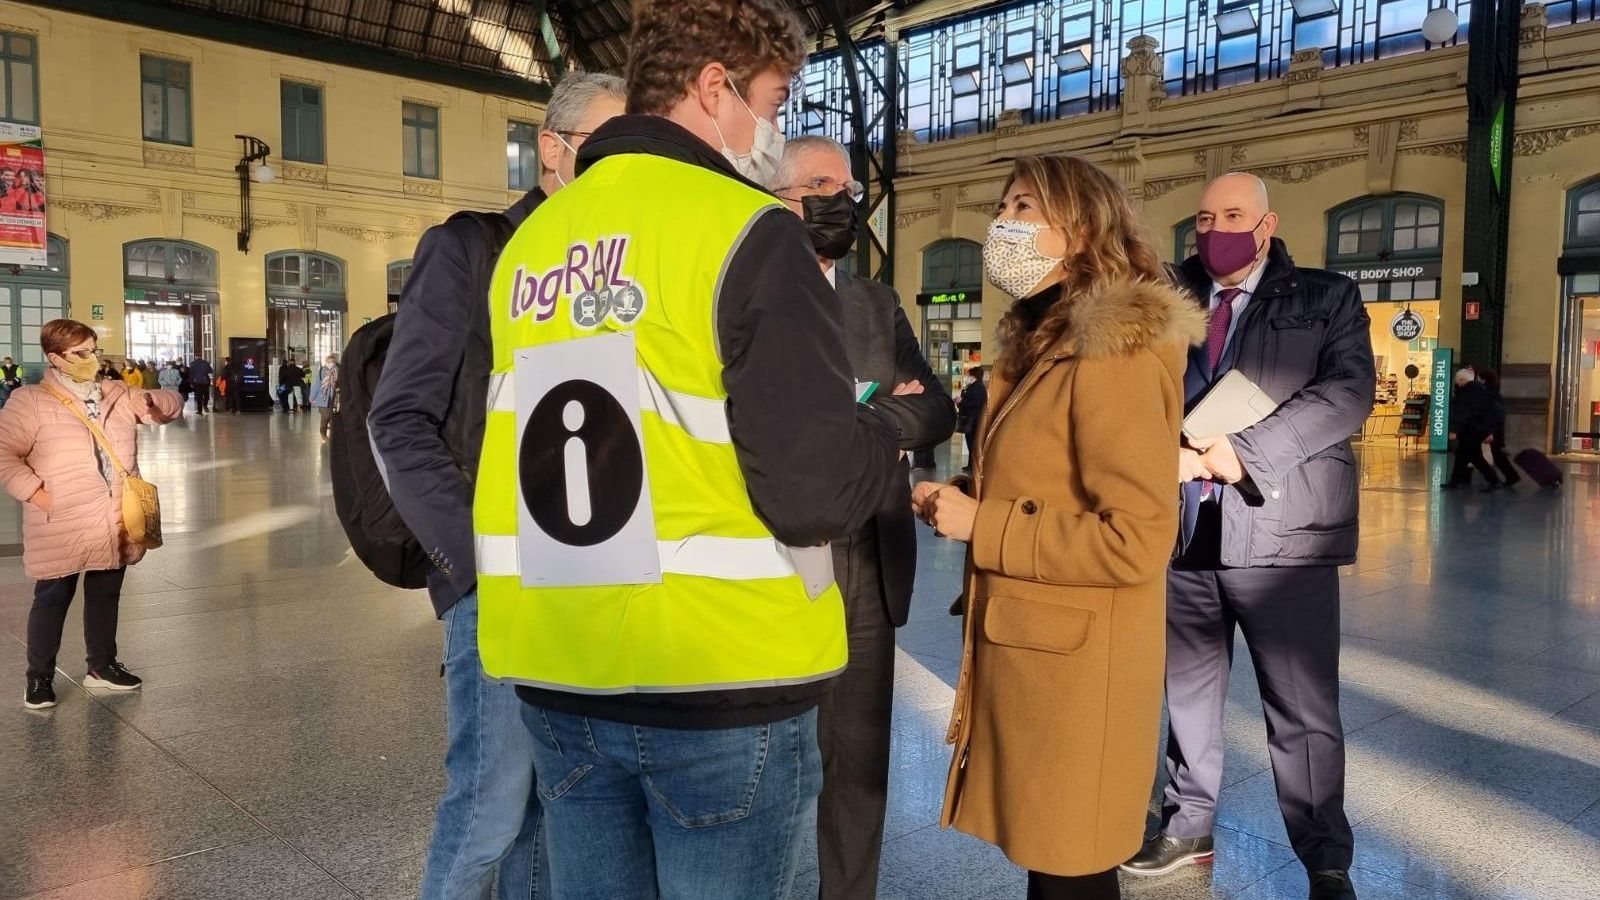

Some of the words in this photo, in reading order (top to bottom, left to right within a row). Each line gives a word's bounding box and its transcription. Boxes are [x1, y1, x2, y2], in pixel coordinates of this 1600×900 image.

[511, 238, 631, 322] logRAIL
[1360, 268, 1390, 280] BODY
[1436, 359, 1446, 379] THE
[1435, 381, 1445, 407] BODY
